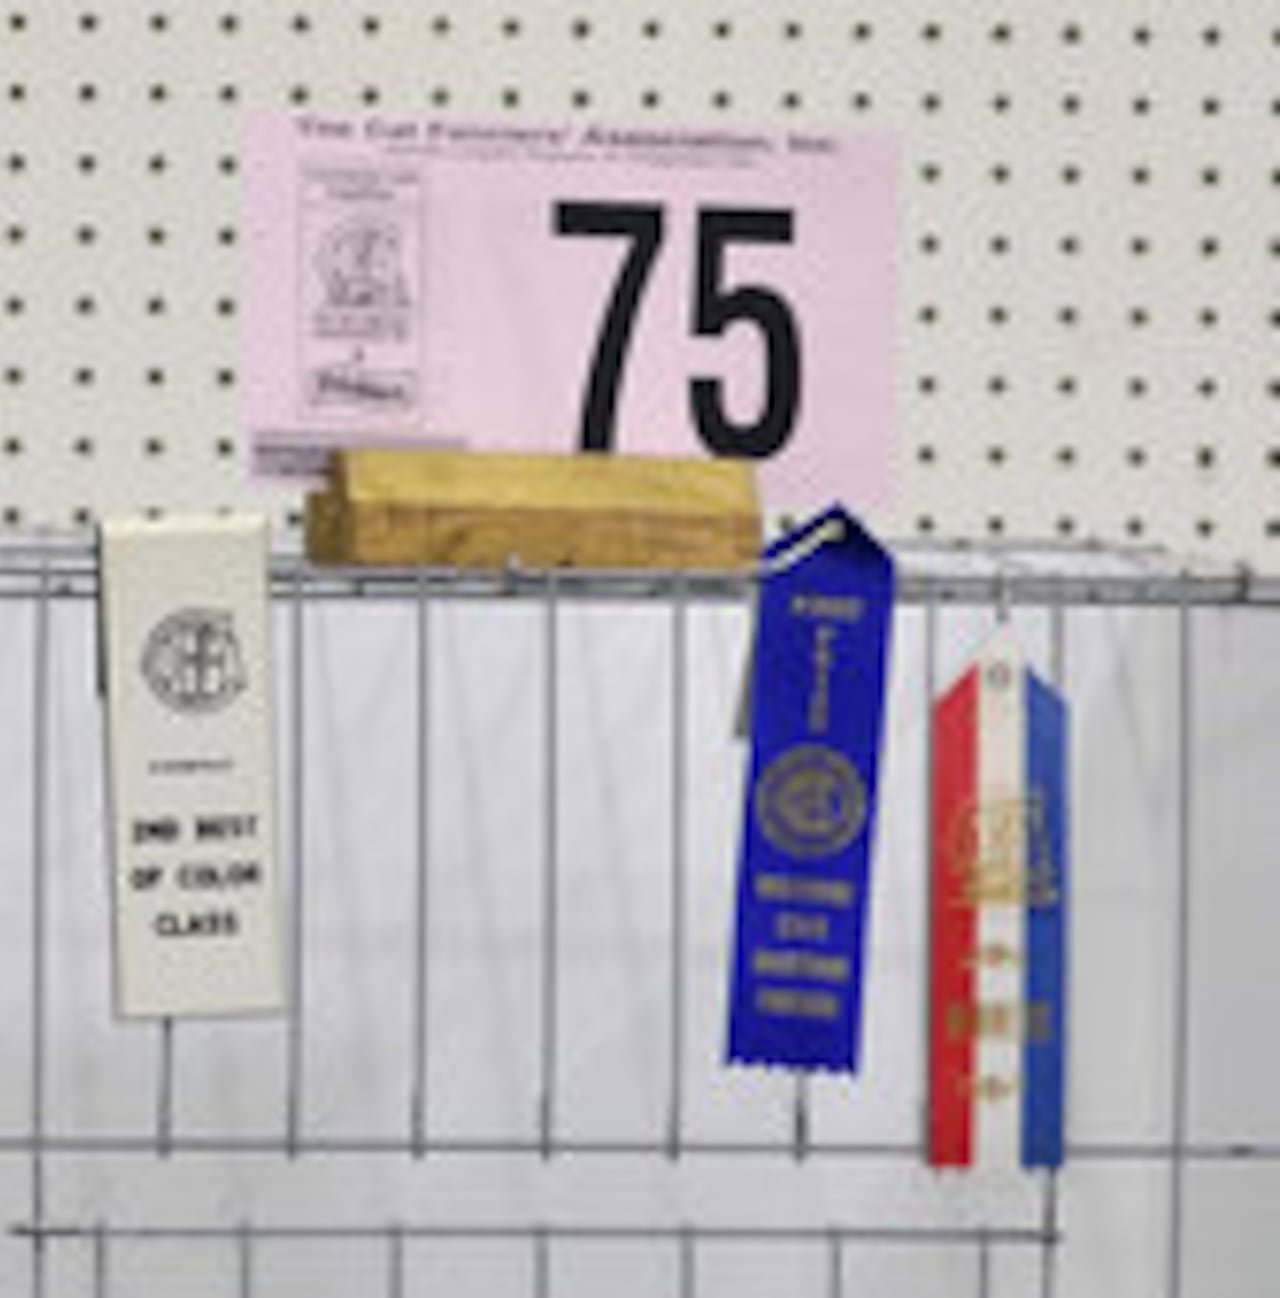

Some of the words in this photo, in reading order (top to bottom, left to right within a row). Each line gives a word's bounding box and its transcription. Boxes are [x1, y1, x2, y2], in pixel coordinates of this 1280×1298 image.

[551, 202, 803, 460] 75
[194, 813, 258, 844] BEST
[128, 863, 164, 892] OF
[175, 860, 263, 892] COLOR
[152, 908, 241, 940] CLASS
